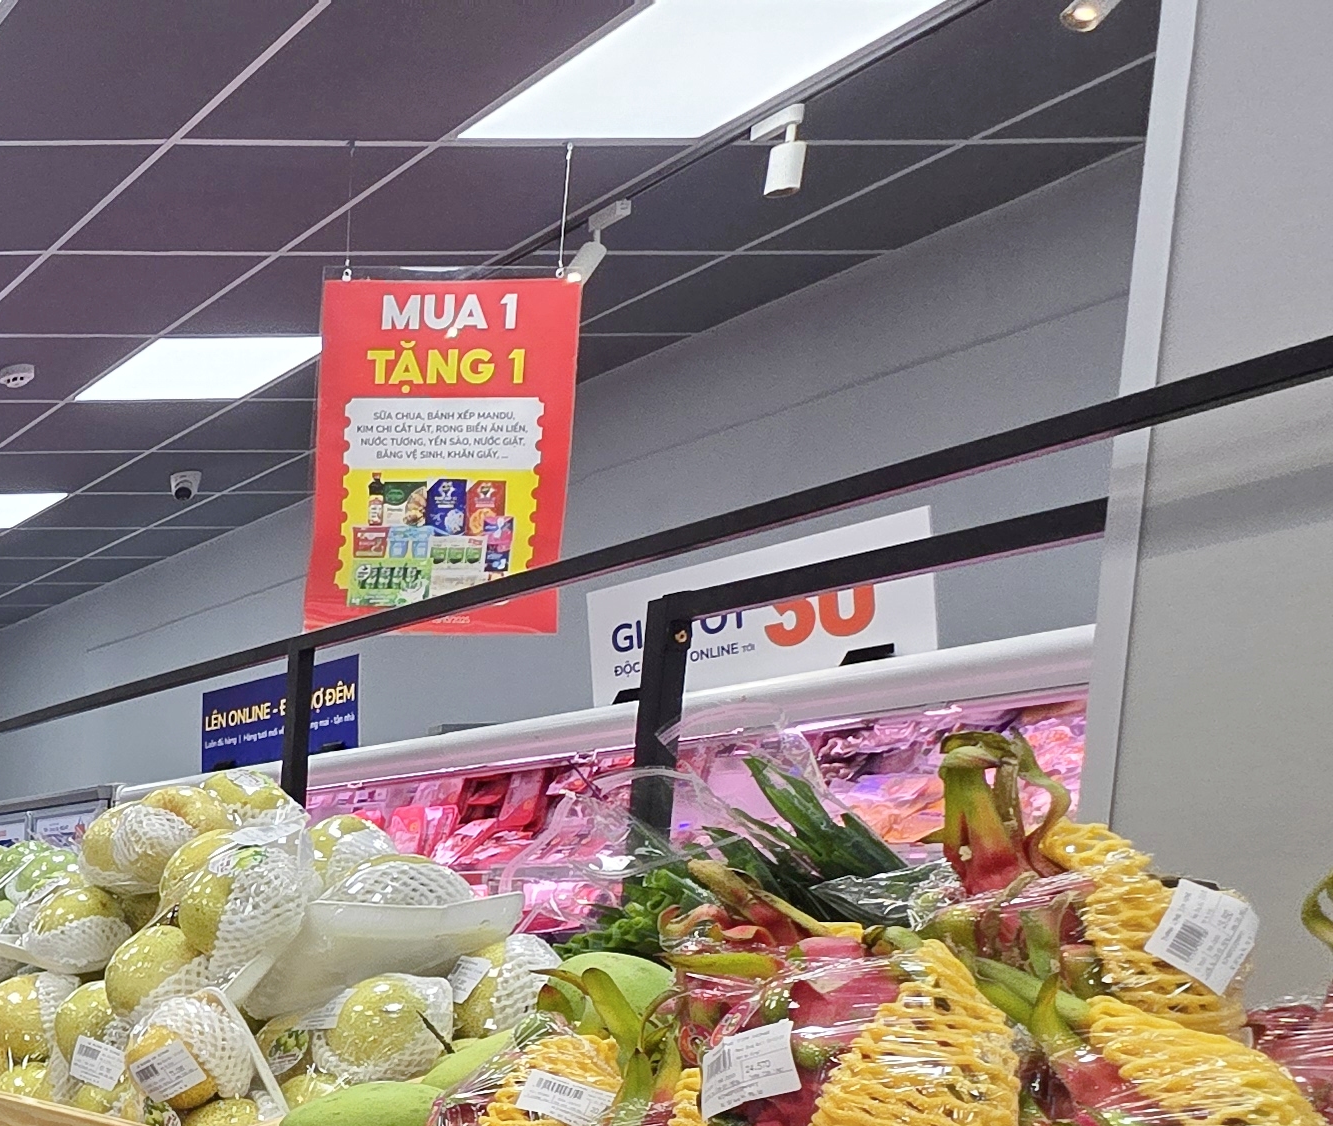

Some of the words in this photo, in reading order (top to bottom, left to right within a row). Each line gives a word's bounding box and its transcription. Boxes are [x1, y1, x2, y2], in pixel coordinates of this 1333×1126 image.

[382, 293, 488, 331] MUA
[500, 293, 518, 330] 1
[367, 340, 495, 393] TẶNG
[508, 348, 526, 384] 1
[614, 659, 641, 678] ĐỘC
[690, 643, 740, 662] ONLINE
[205, 709, 227, 731] LÊN
[228, 702, 271, 726] ONLINE
[325, 681, 356, 707] ĐÊM
